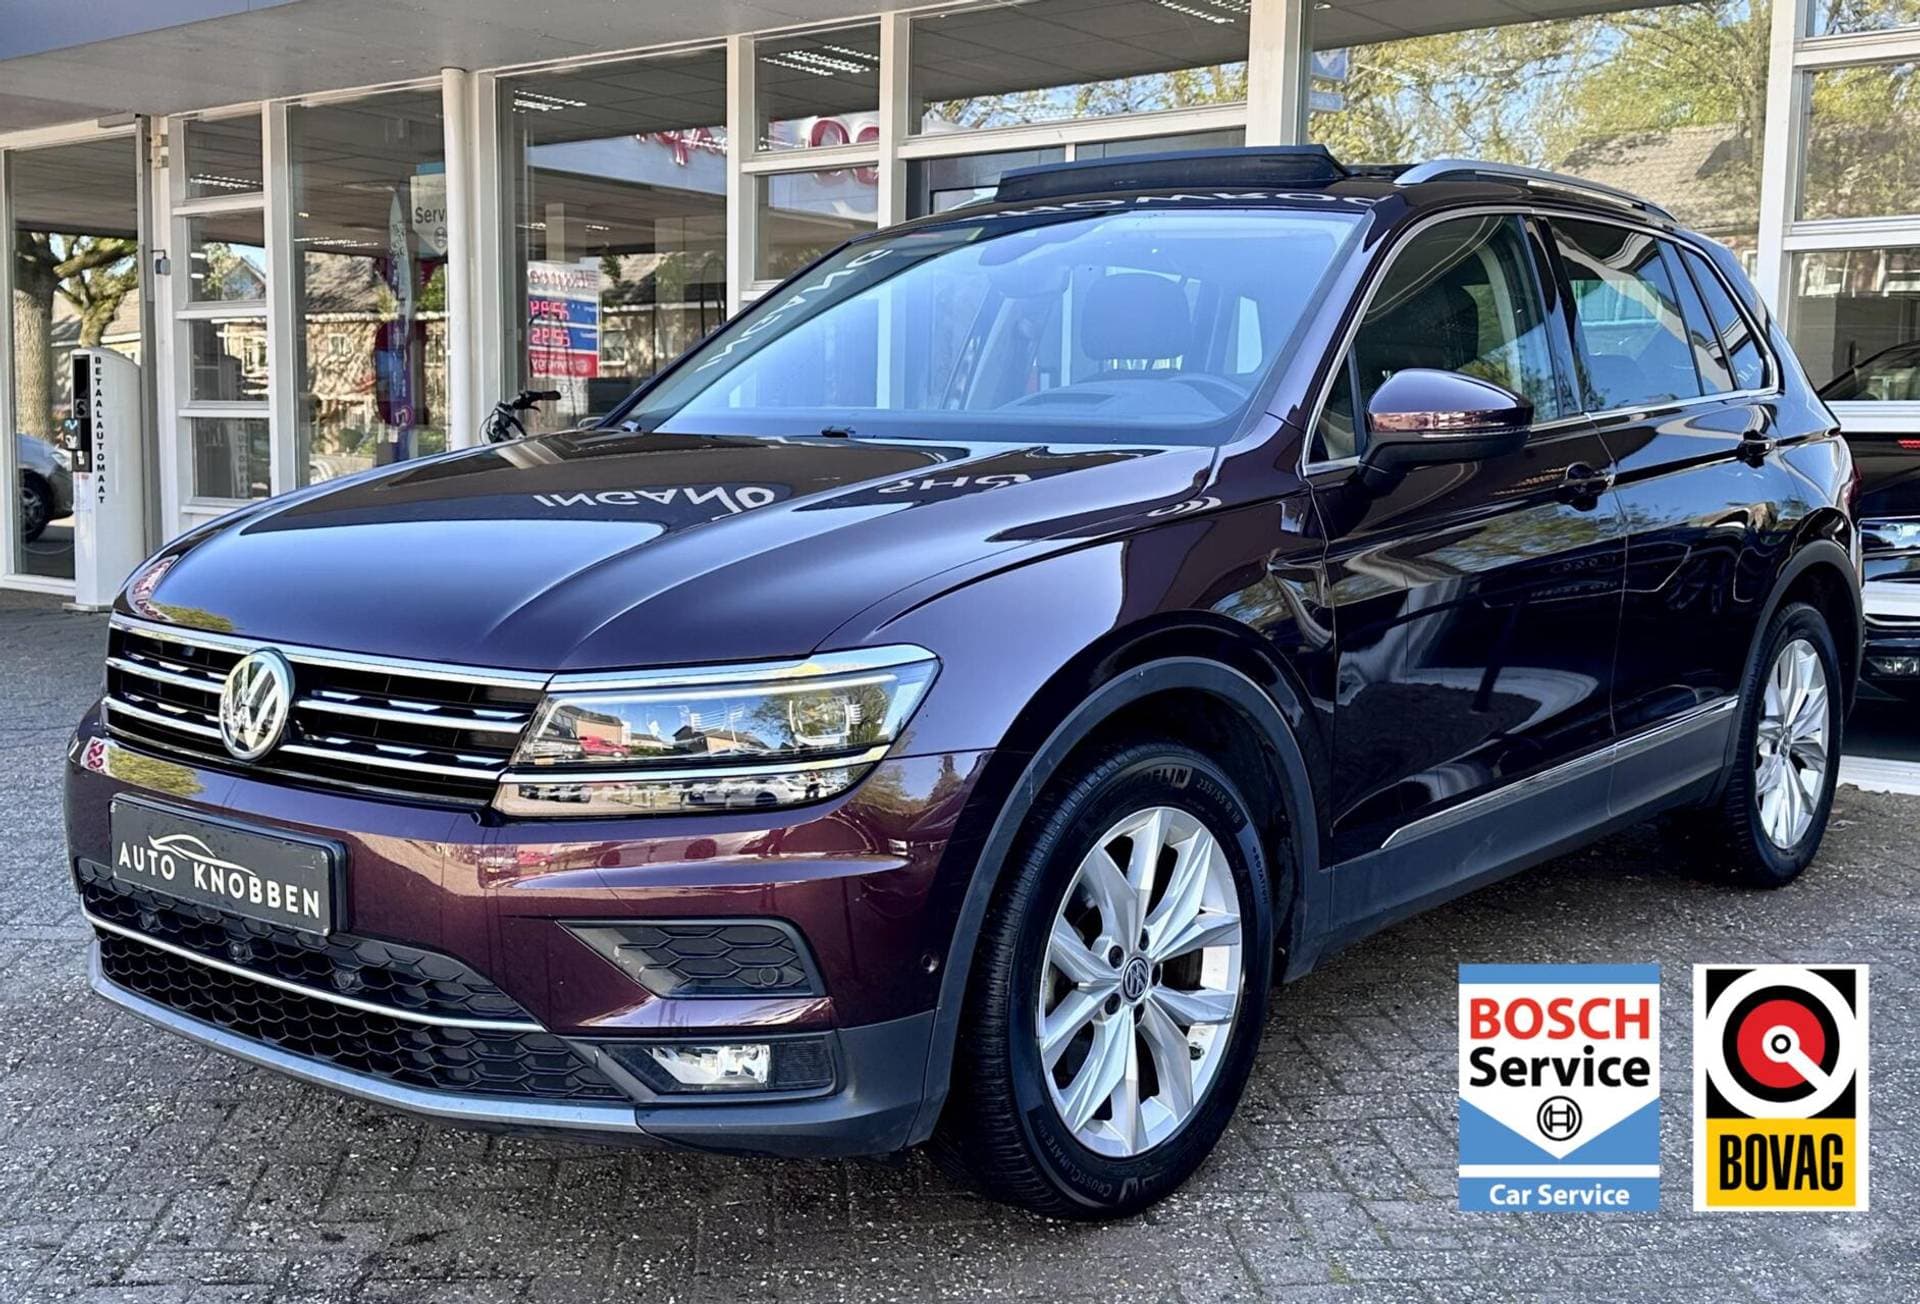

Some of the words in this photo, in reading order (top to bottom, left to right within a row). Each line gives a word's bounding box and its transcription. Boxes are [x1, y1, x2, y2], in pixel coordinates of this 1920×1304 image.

[415, 206, 445, 224] Serv
[94, 356, 105, 504] BETAALAUTOMAAT
[118, 842, 176, 880] AUTO
[193, 861, 320, 919] KNOBBEN
